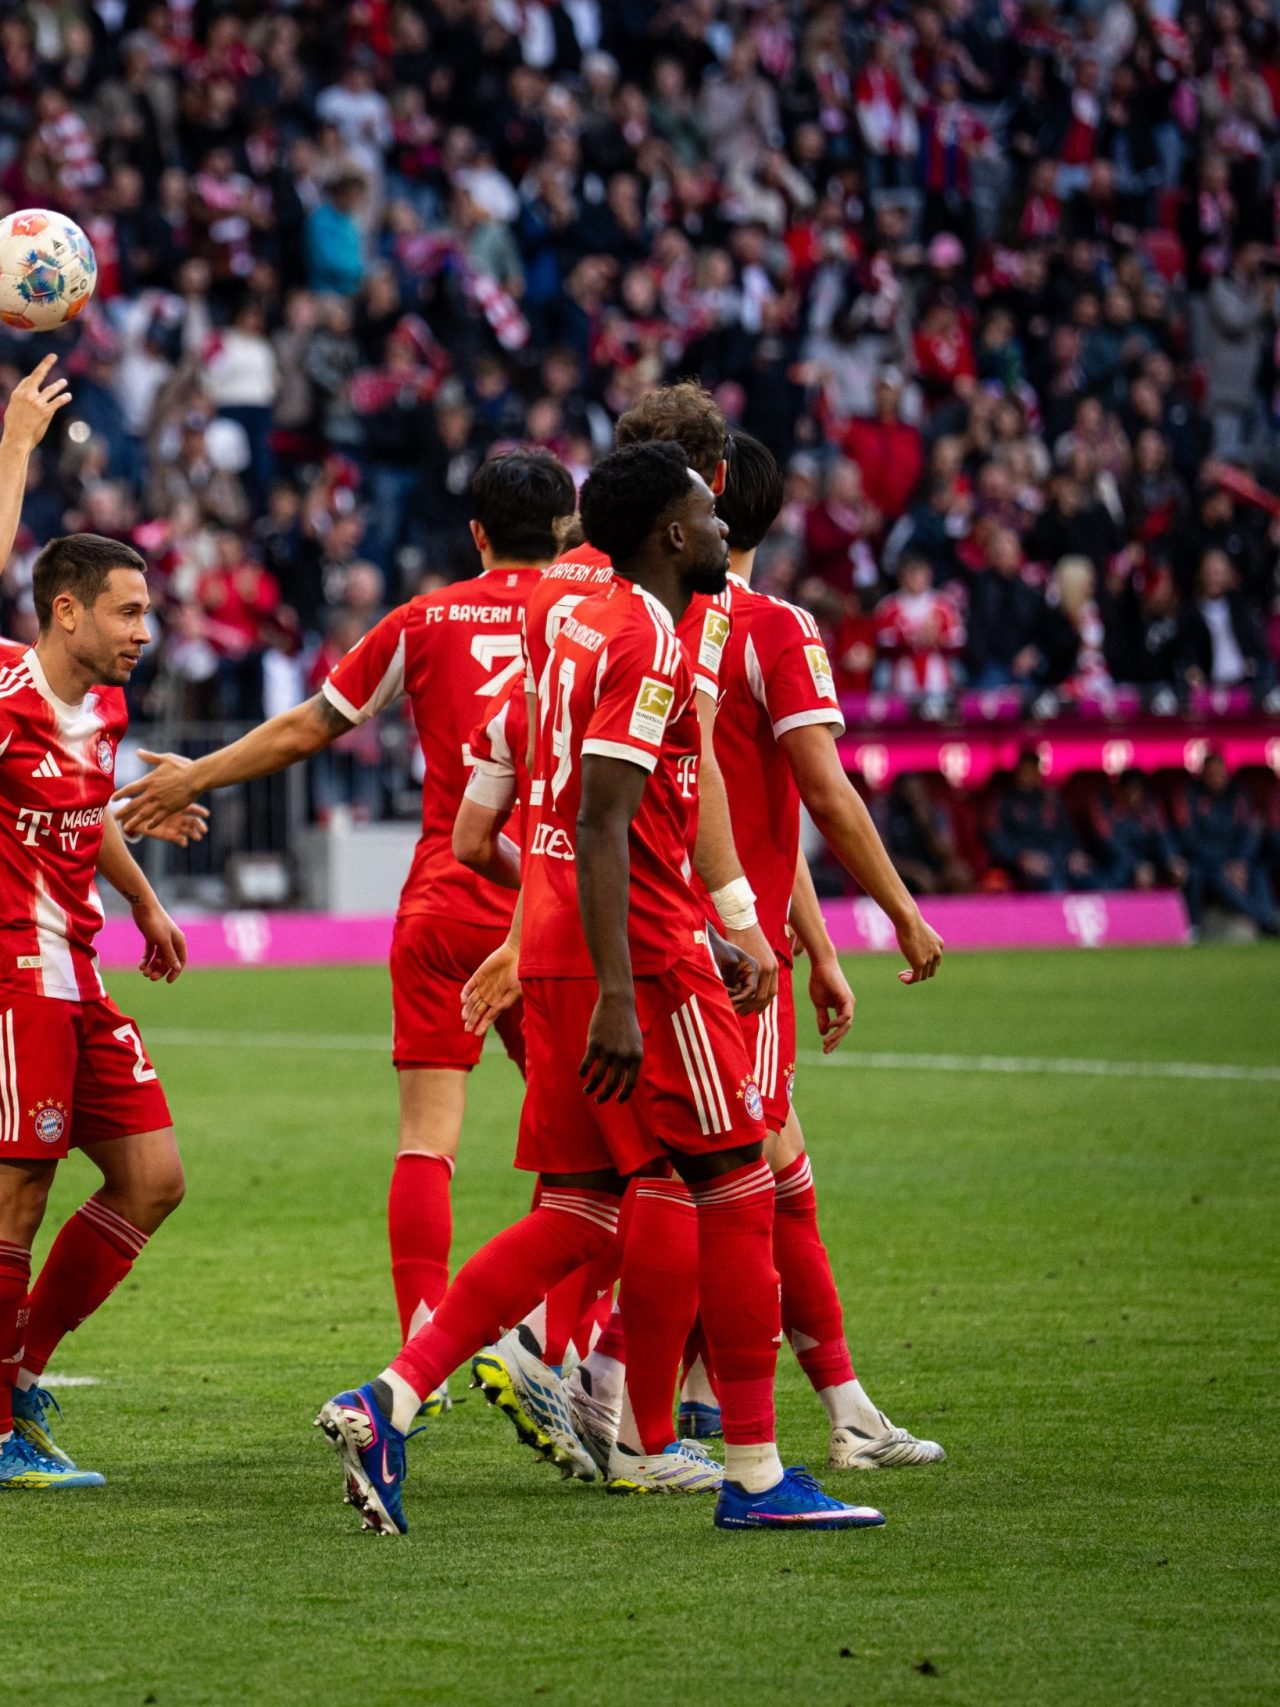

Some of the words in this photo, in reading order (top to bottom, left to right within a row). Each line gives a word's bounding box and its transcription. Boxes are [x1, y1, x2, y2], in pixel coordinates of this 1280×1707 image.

[425, 605, 445, 625] FC
[448, 604, 513, 623] BAYERN
[15, 807, 53, 847] T
[59, 831, 80, 851] TV
[112, 1023, 158, 1083] 2
